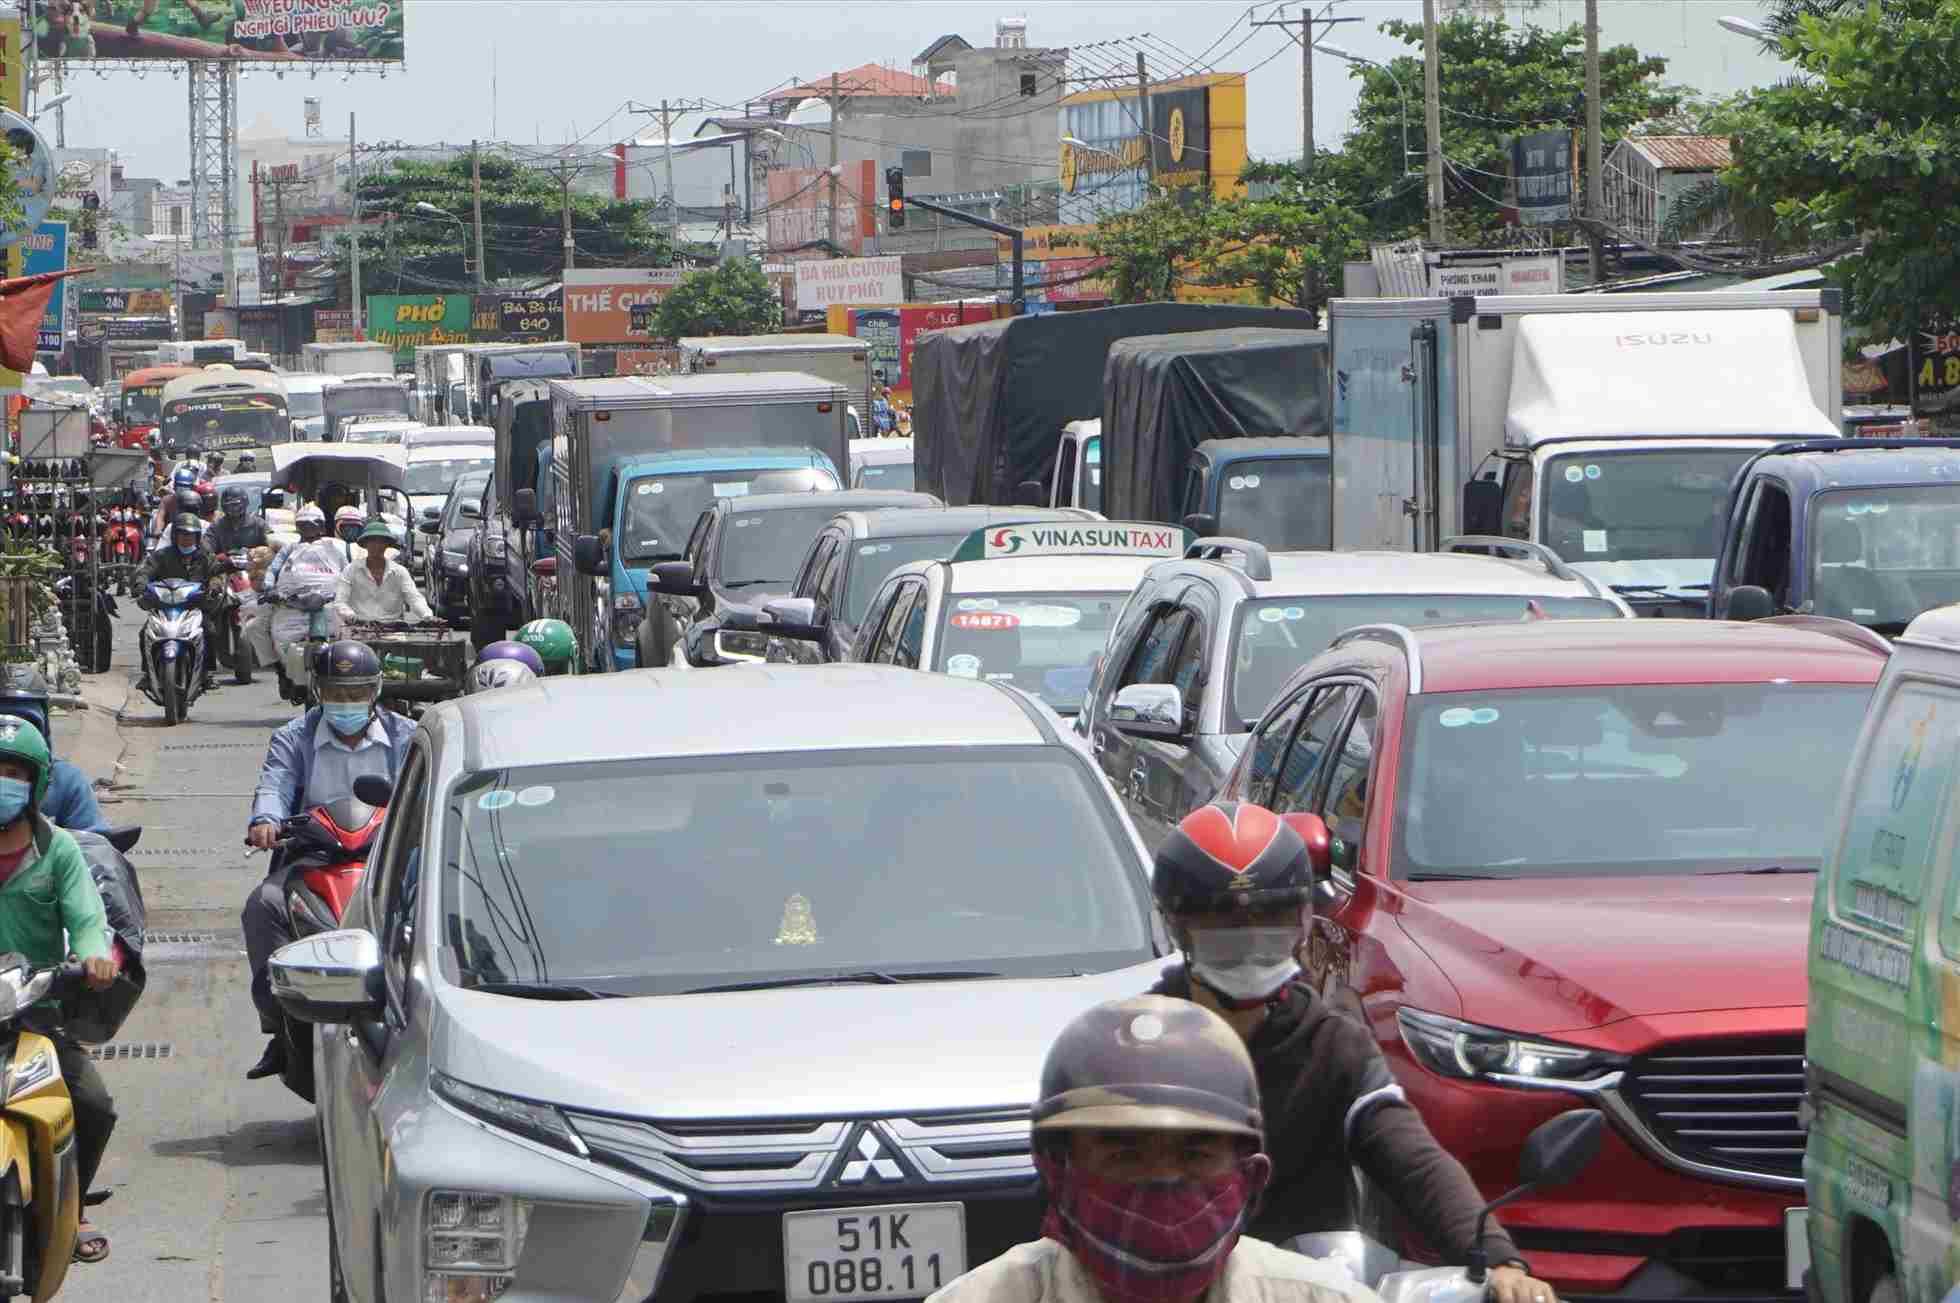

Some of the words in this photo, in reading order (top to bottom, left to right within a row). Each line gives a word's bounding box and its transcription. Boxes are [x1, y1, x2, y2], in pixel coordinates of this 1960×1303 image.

[396, 296, 447, 322] PHỞ
[568, 287, 613, 313] THẾ
[941, 312, 957, 324] LG
[1615, 333, 1712, 347] ISUZU
[837, 1213, 912, 1252] 51K
[807, 1253, 943, 1296] 088.11
